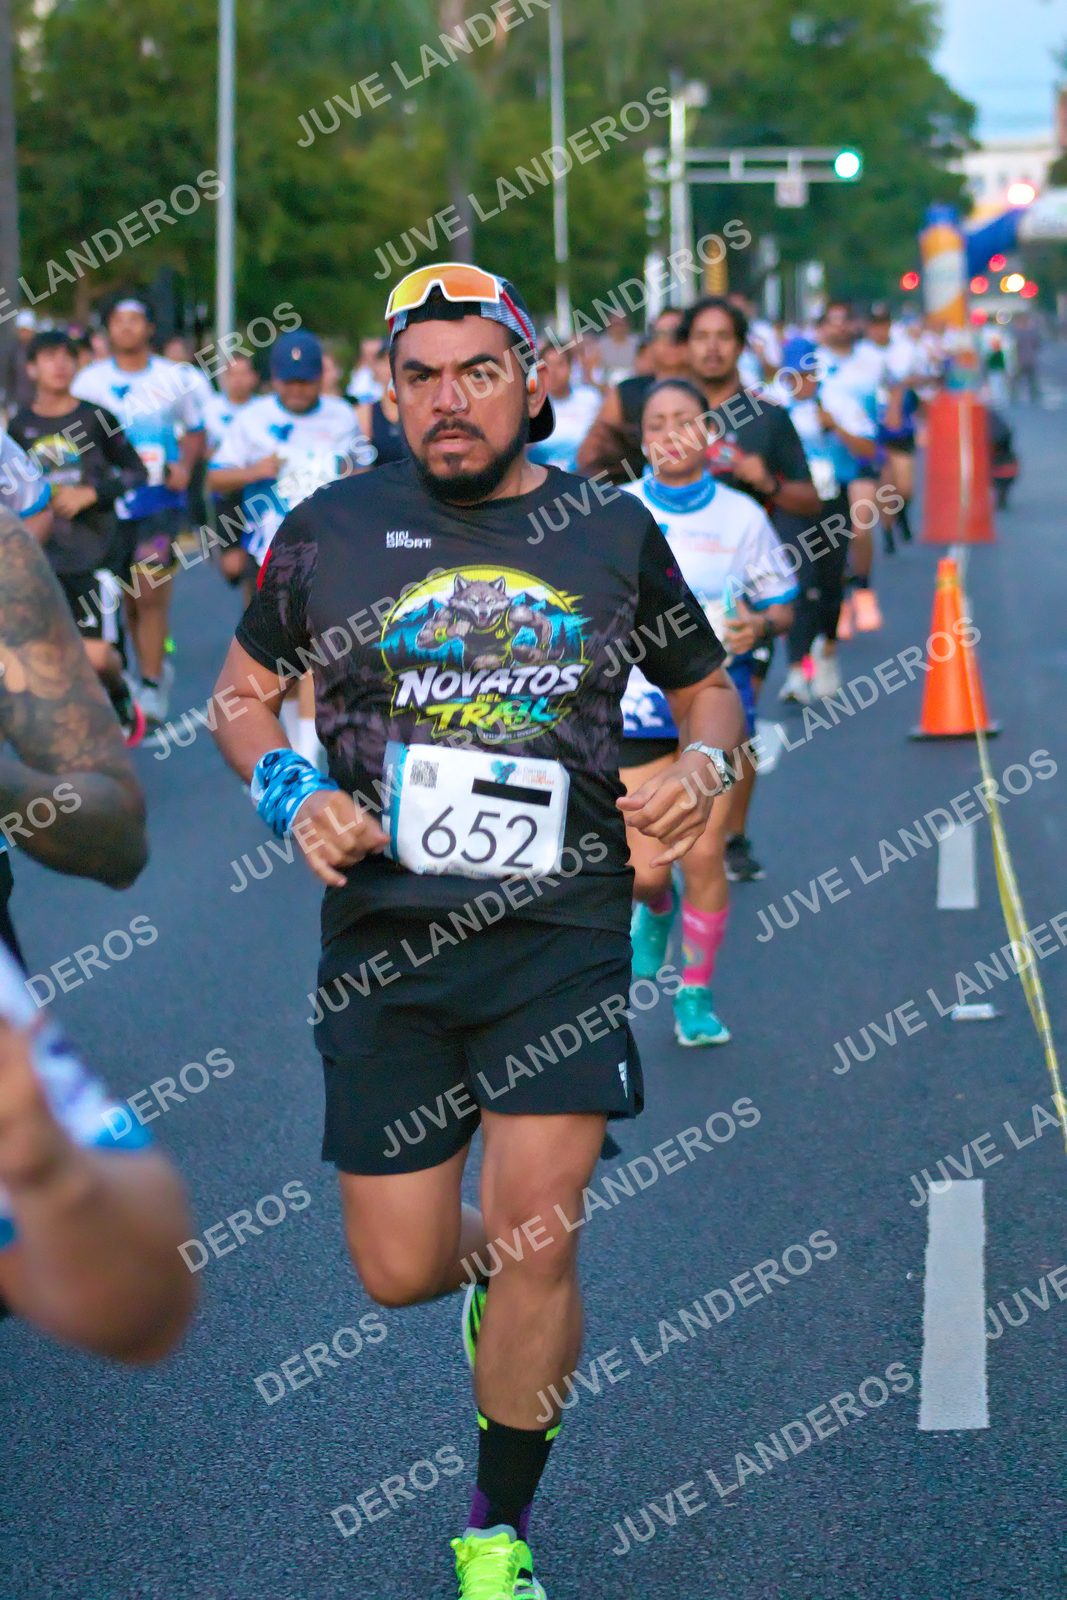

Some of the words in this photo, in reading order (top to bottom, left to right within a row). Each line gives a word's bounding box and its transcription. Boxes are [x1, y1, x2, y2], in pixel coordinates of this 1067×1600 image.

[386, 530, 409, 540] KIN
[396, 664, 586, 707] NOVATOS
[426, 696, 558, 730] TRAIL
[421, 805, 539, 869] 652
